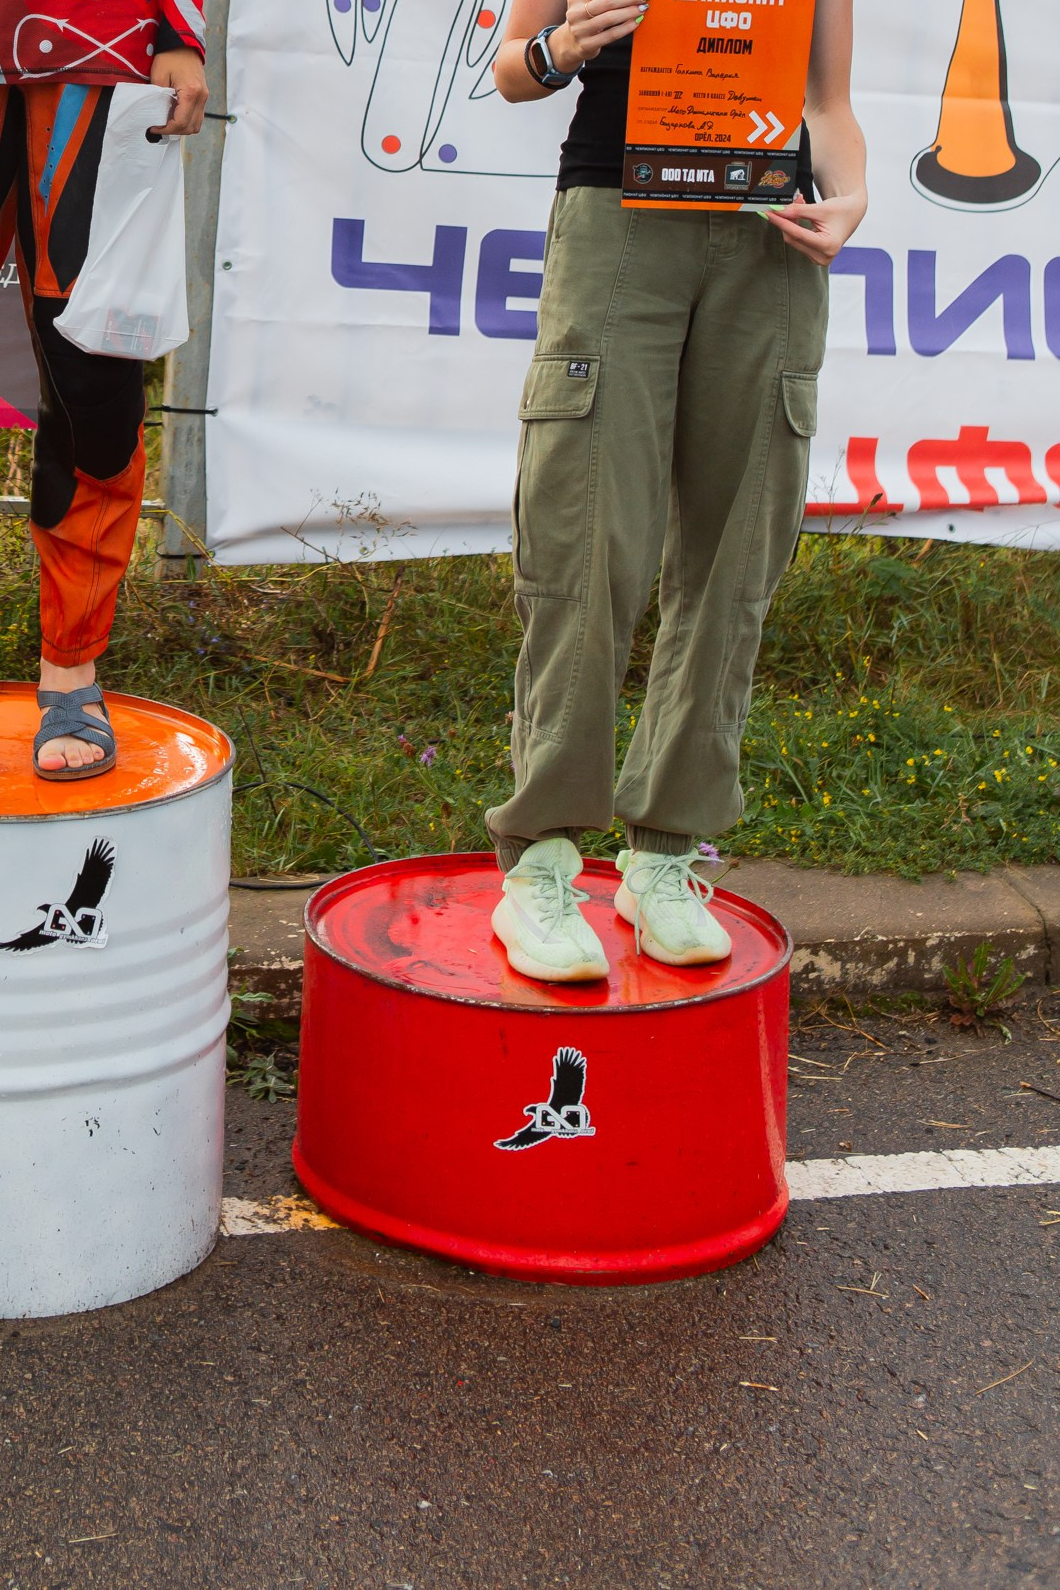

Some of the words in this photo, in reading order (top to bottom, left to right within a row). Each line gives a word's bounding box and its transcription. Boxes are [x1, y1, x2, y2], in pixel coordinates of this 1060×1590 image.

[706, 10, 752, 30] ЦФО
[696, 37, 753, 55] ДИПЛОМ
[640, 66, 672, 74] НАГРАЖДАЕТСЯ
[675, 63, 703, 76] Галкина
[715, 133, 731, 143] 2024
[661, 168, 679, 181] ООО
[682, 169, 695, 183] ТД
[697, 169, 715, 183] ИТА
